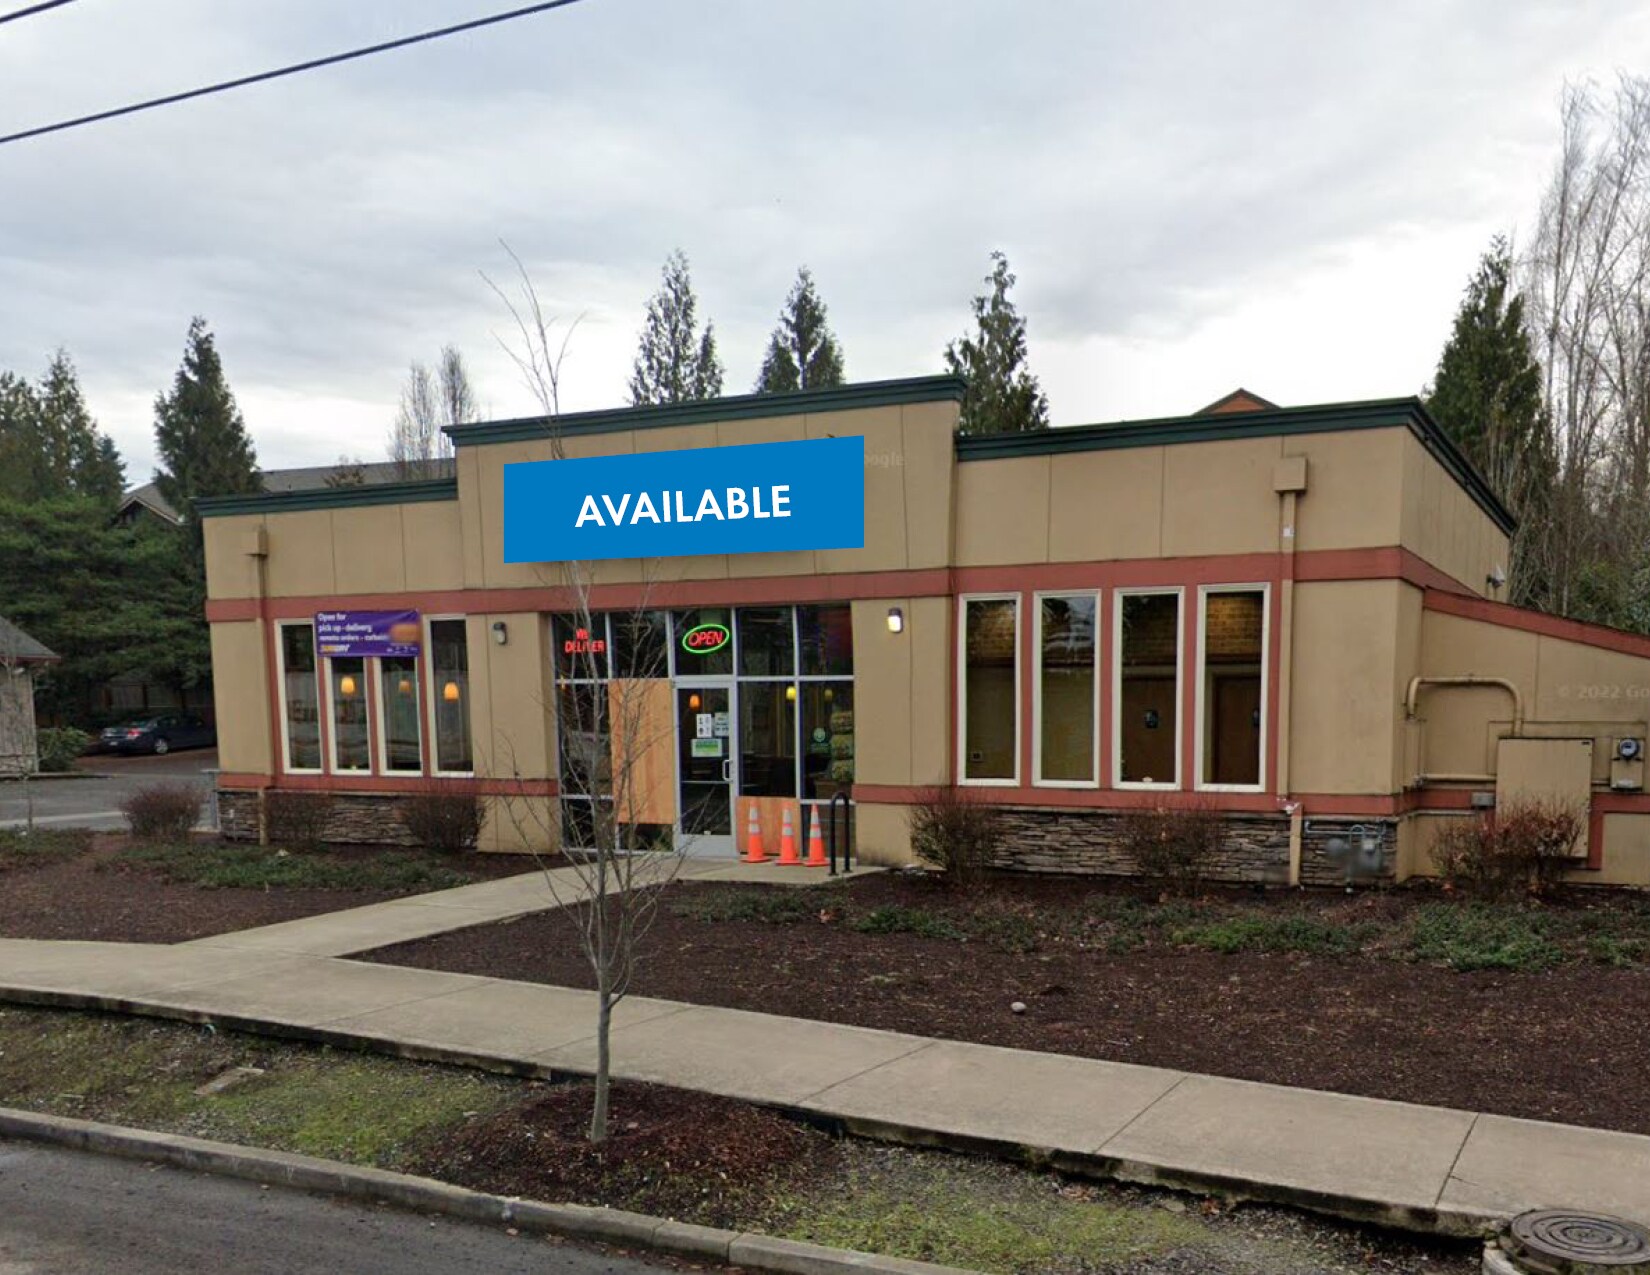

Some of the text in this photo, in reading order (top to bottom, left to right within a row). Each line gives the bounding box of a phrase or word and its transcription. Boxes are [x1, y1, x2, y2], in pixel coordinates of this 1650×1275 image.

[318, 612, 346, 622] Open for
[688, 630, 723, 647] OPEN
